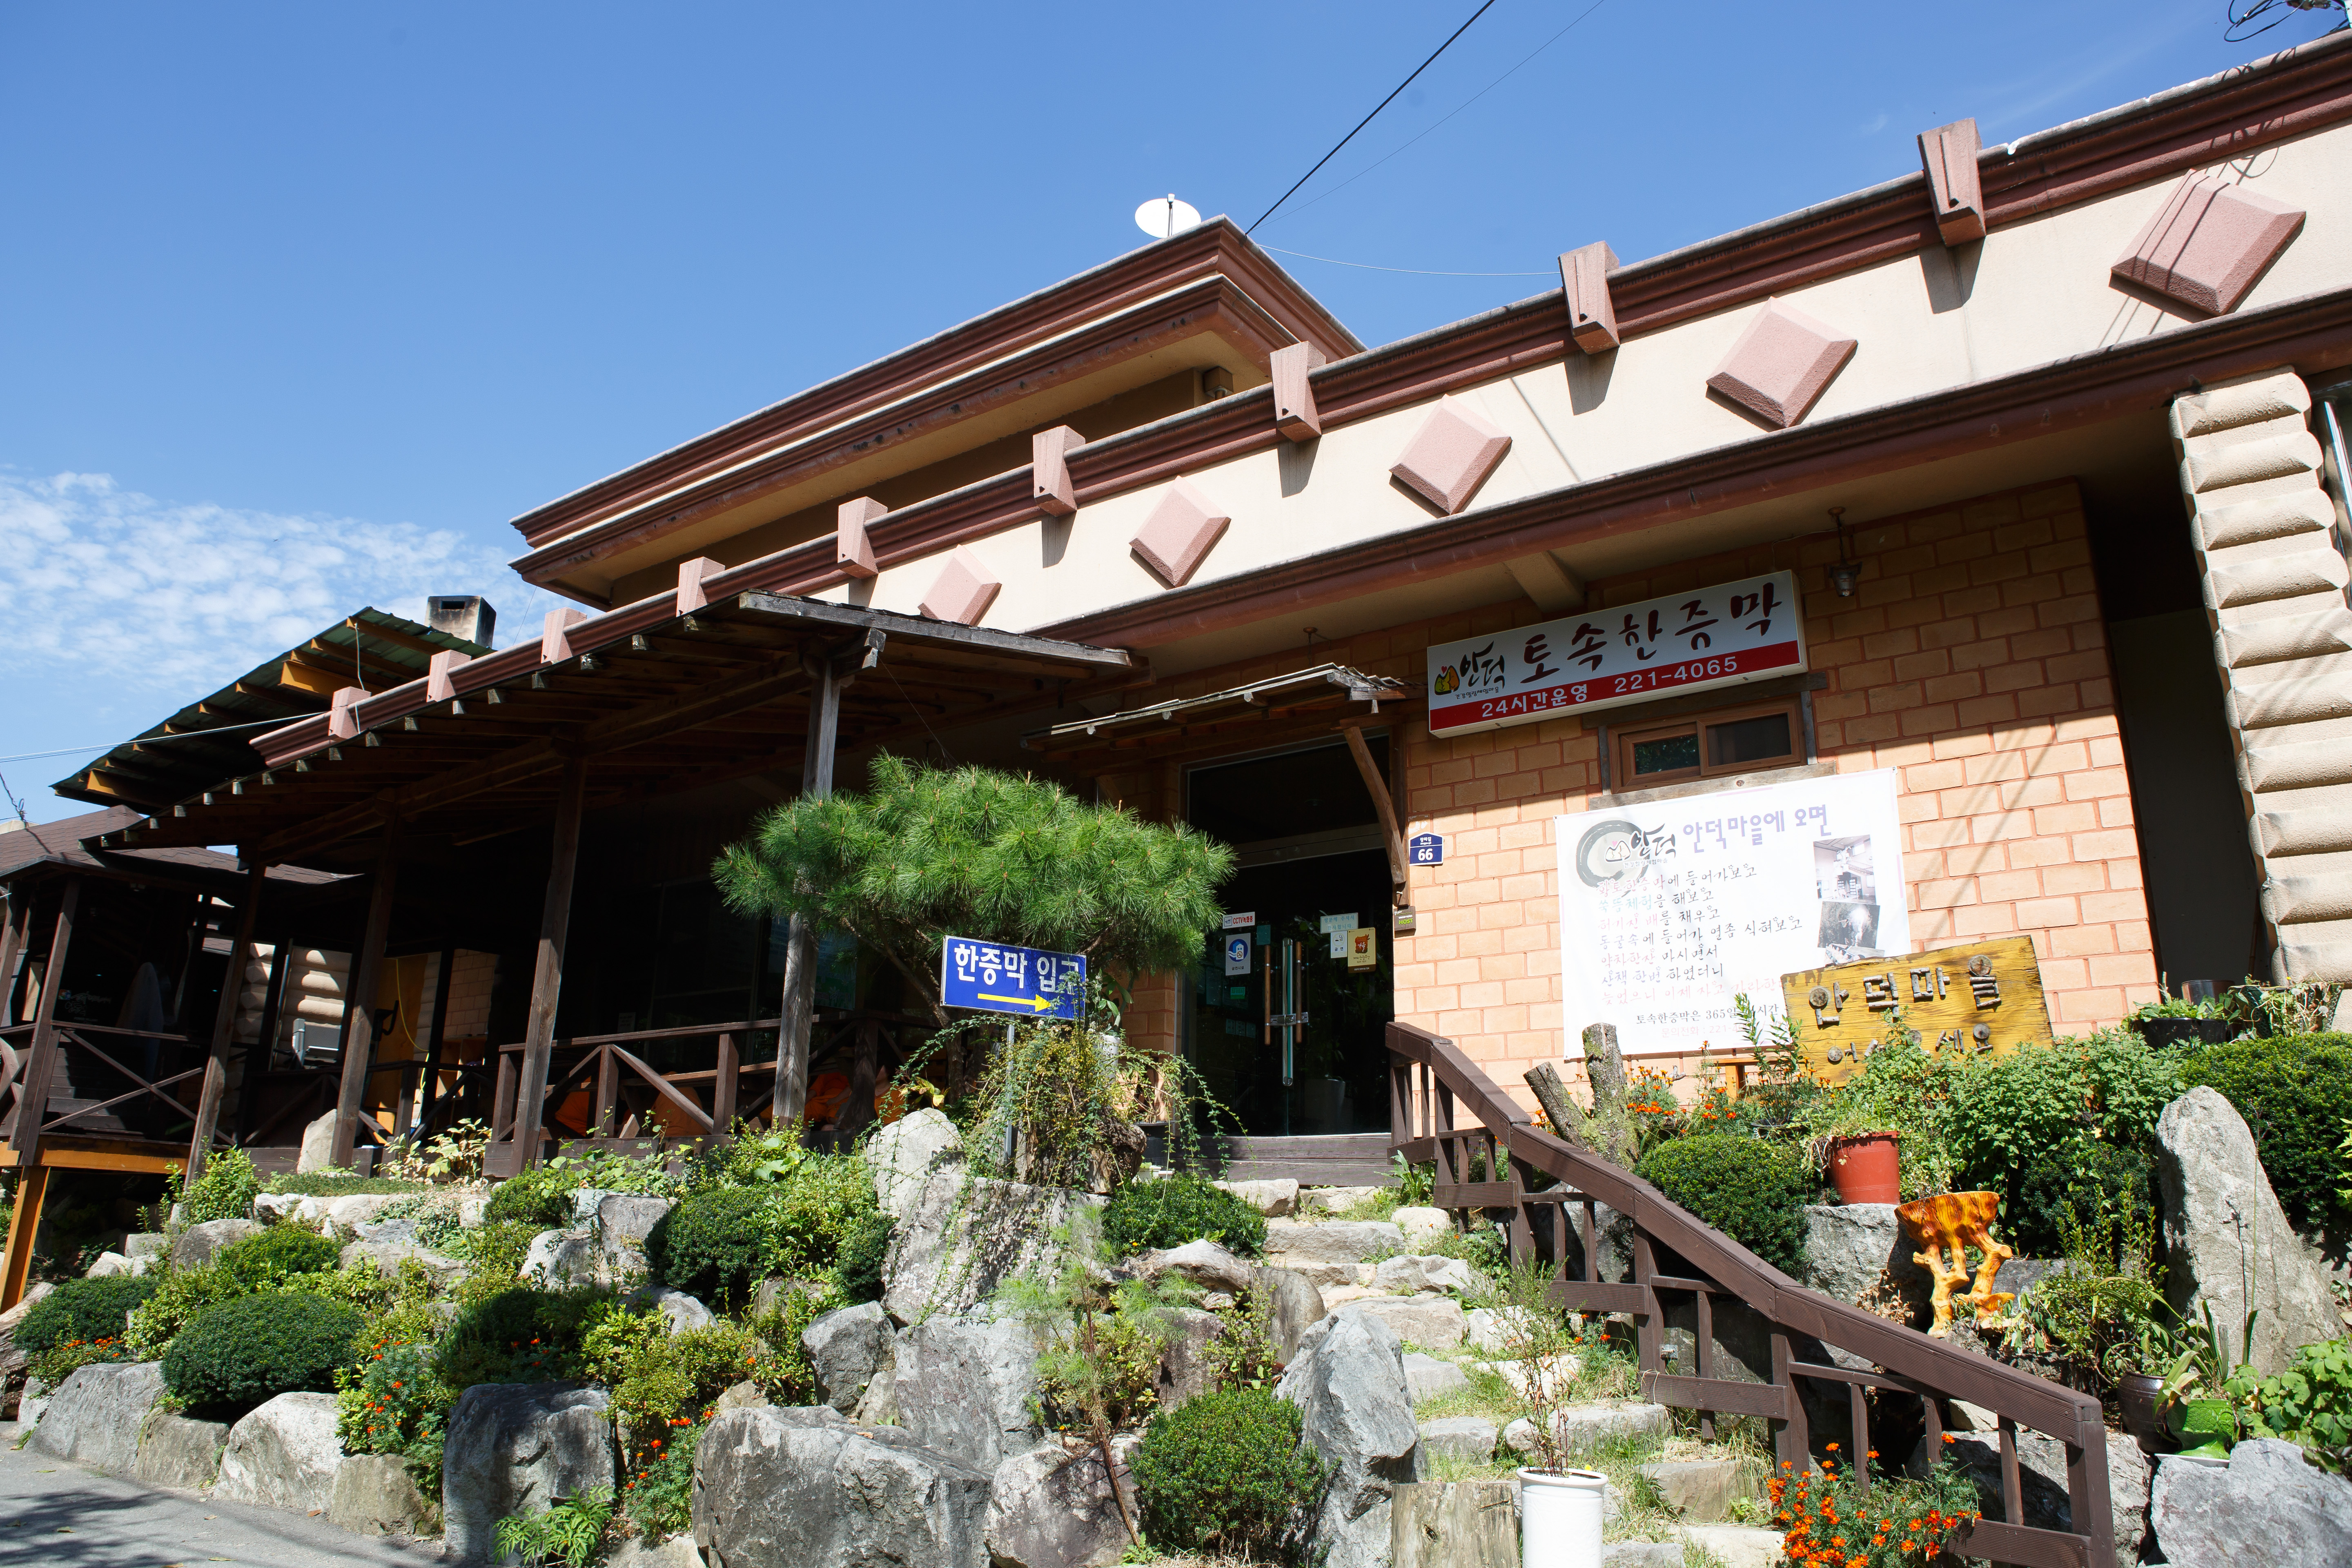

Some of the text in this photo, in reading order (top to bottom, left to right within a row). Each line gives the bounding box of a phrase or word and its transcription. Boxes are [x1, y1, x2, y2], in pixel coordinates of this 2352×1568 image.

[1459, 582, 1782, 689] 안덕 토속한증막
[1454, 686, 1499, 699] 건강힐링체험마을
[1482, 655, 1738, 717] 24시간운영 221-4065
[1631, 823, 1676, 858] 안덕
[1683, 804, 1832, 853] 안덕마을에 오면
[1418, 849, 1433, 861] 66
[1624, 858, 1668, 868] 건강힐링체험마을
[1596, 863, 1757, 898] 황토한증막에 들어가보고
[1598, 887, 1714, 913] 쑥뜸체험을 해보고
[1233, 915, 1253, 924] CCTV녹화중
[1597, 905, 1720, 931] 허기진 배를 채우고
[1599, 916, 1802, 949] 동굴속에 들어가 열좀 식혀보고
[954, 943, 1028, 989] 한증막
[1601, 944, 1718, 968] 약차한잔 마시면서
[1601, 963, 1724, 987] 산책 한번 하였더니
[1601, 987, 1656, 1005] 늦었으니
[1665, 986, 1690, 1000] 이제
[1697, 980, 1725, 996] 자고
[1809, 955, 2002, 1027] 안덕마을
[1635, 1011, 1701, 1025] 토속한증막은
[1661, 1025, 1699, 1038] 문의전화
